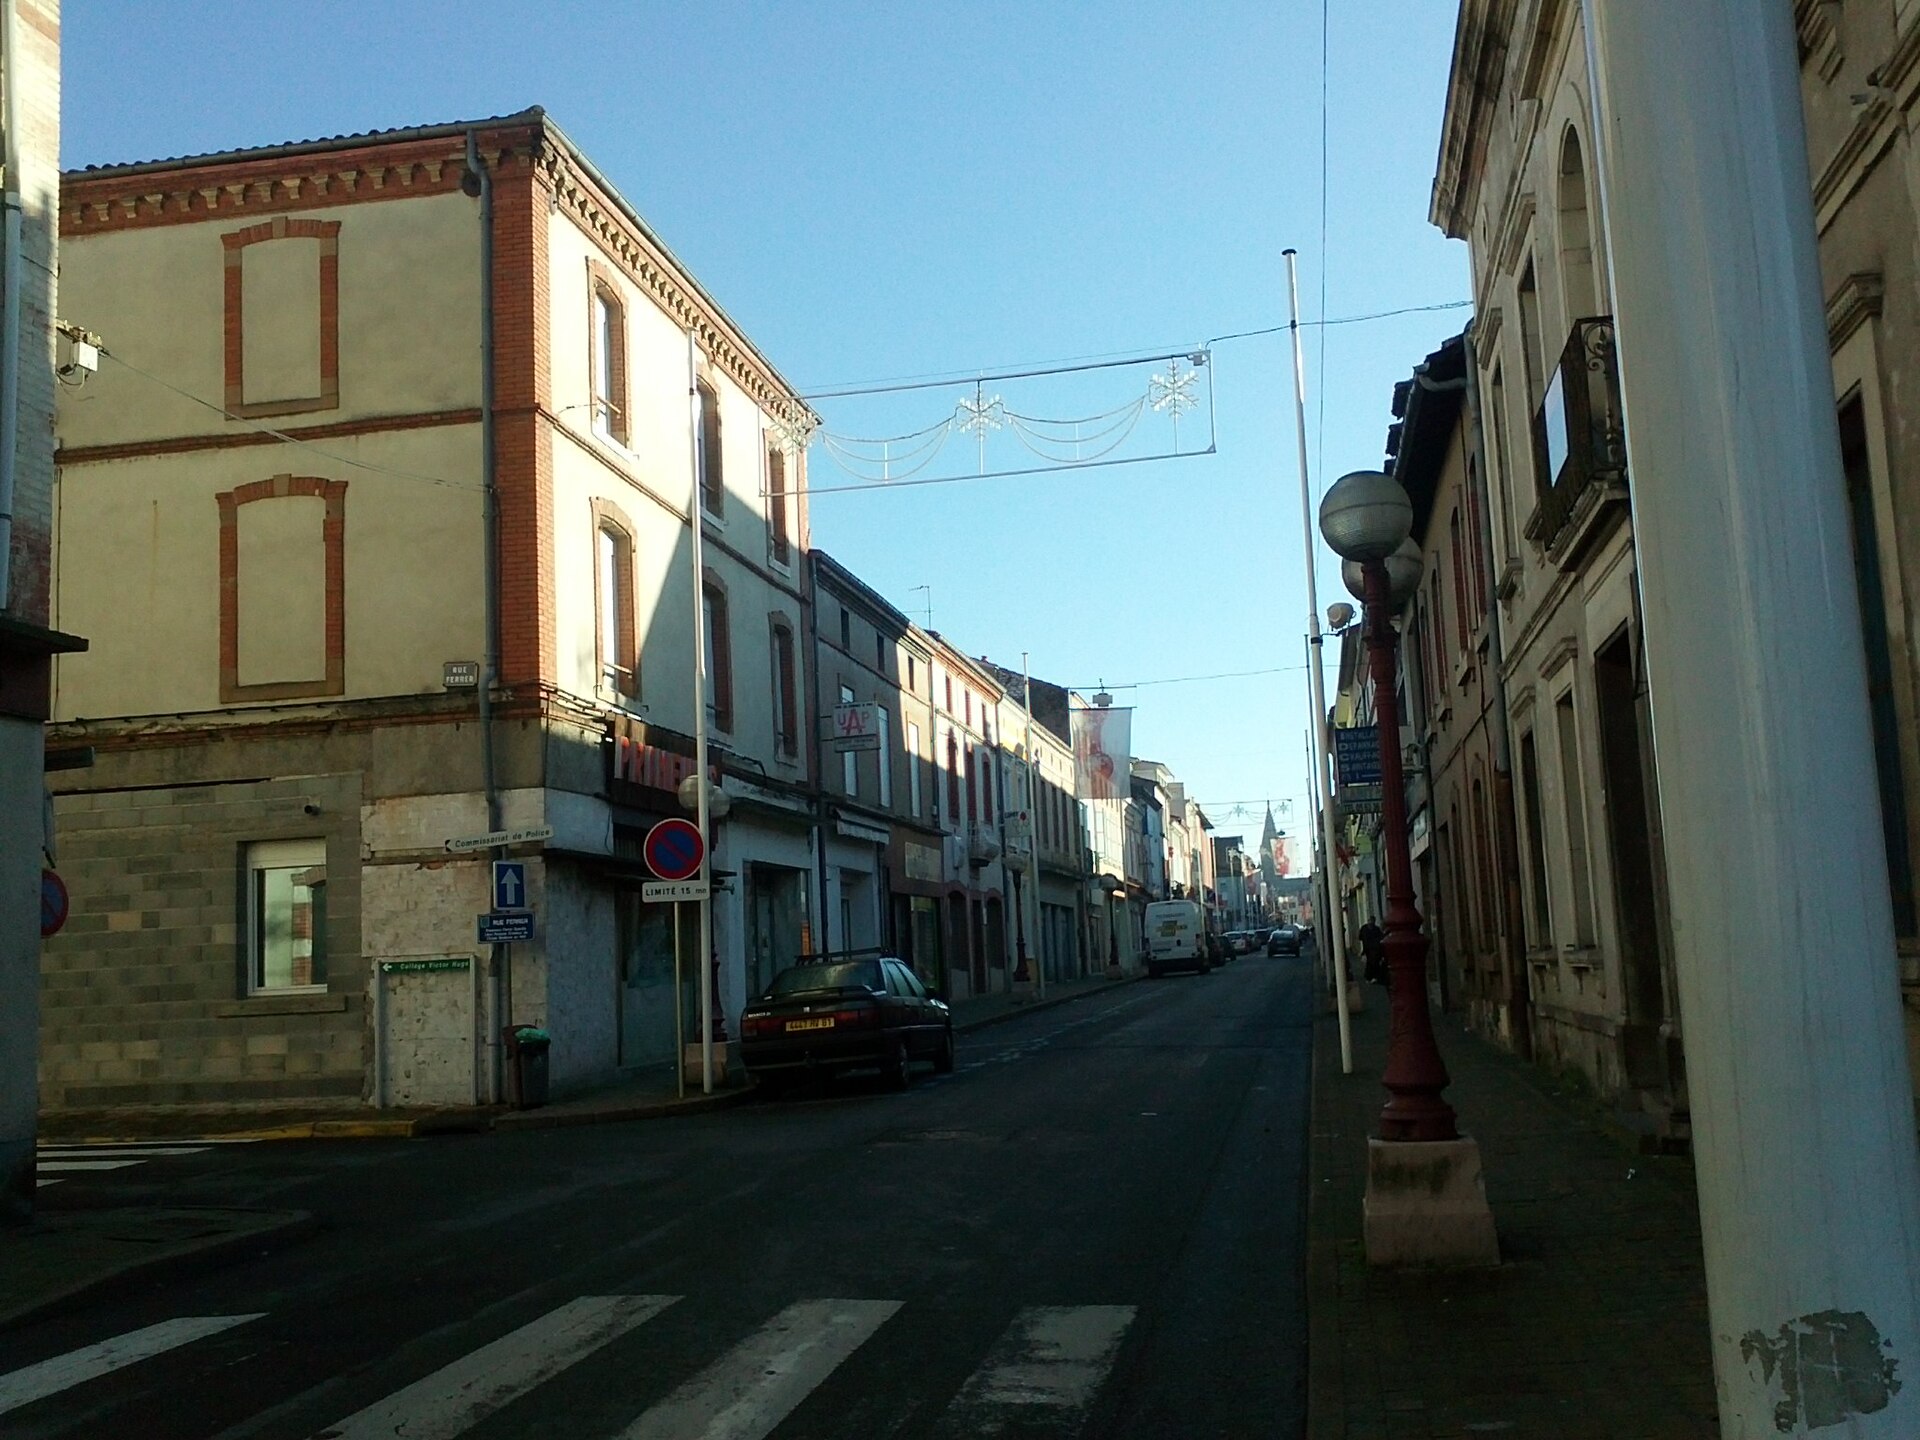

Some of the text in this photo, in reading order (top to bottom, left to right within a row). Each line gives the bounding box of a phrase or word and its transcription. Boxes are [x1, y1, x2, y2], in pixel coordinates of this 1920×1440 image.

[452, 666, 467, 674] RUE
[837, 708, 870, 736] UAP
[455, 829, 550, 849] Commissariat de Police
[645, 885, 677, 897] LIMITÉ
[681, 886, 691, 895] 15
